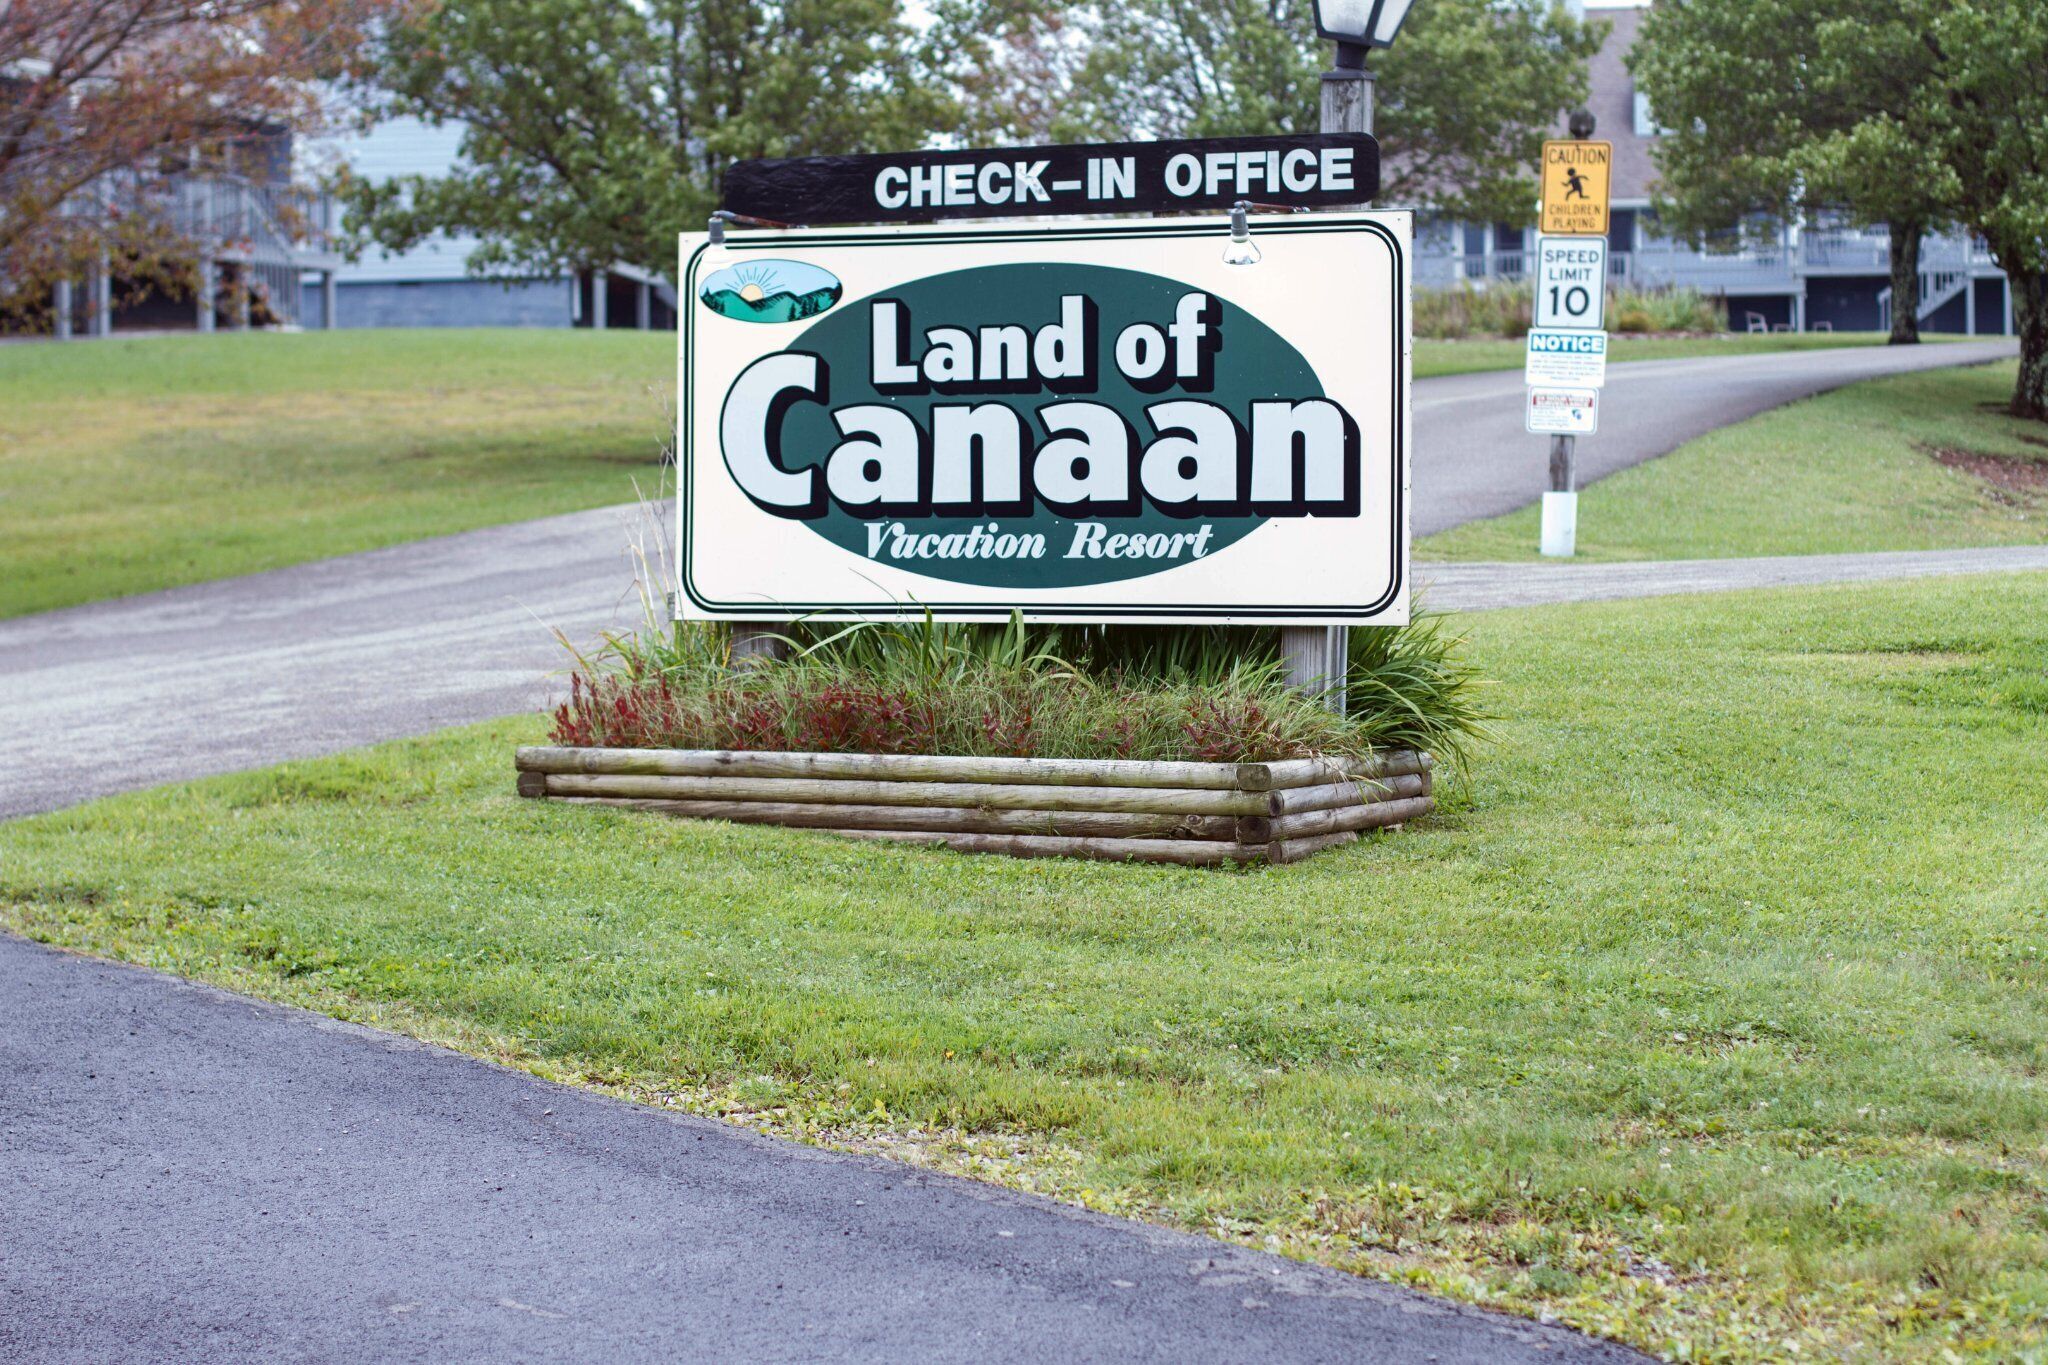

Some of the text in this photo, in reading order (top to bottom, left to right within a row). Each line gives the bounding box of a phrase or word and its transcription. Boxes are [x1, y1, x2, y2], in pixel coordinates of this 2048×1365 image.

[1548, 148, 1607, 164] CAUTION
[1164, 148, 1354, 197] OFFICE
[1549, 203, 1601, 216] CHILDREN
[1552, 217, 1596, 229] PLAYING
[1544, 249, 1600, 264] SPEED
[1549, 268, 1593, 281] LIMIT
[1549, 285, 1590, 316] 10
[872, 292, 1210, 388] Land of
[1532, 335, 1604, 353] NOTICE
[720, 351, 1353, 512] Canaan
[863, 522, 1215, 560] Vacation Resort
